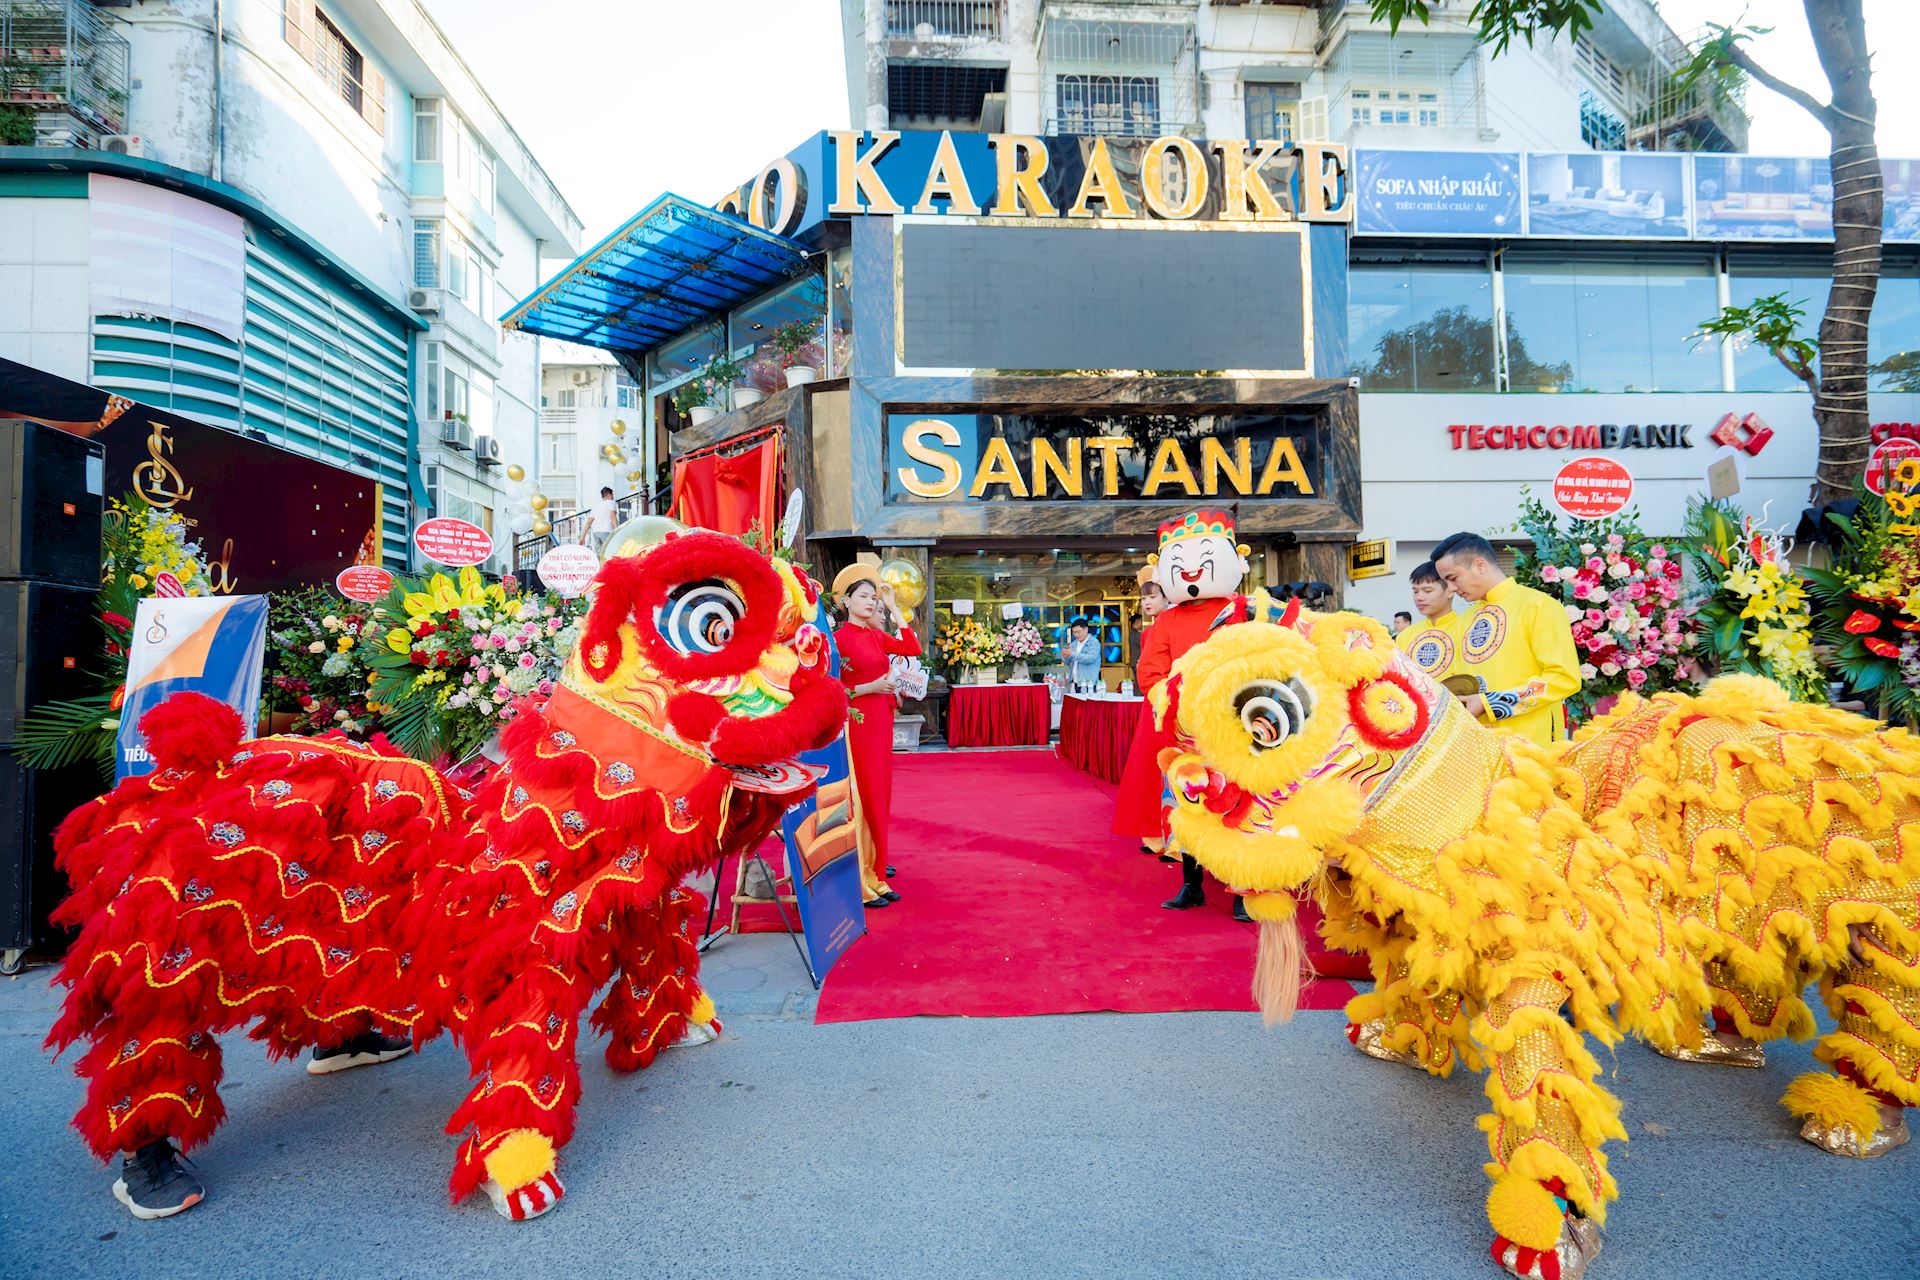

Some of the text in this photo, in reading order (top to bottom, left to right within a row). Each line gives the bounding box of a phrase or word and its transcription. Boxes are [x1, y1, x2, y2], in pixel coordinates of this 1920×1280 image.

[828, 130, 1353, 223] KARAOKE
[1376, 172, 1504, 199] SOFA NHẬP KHẨU
[898, 419, 1316, 499] SANTANA
[1447, 424, 1695, 449] TECHCOMBANK
